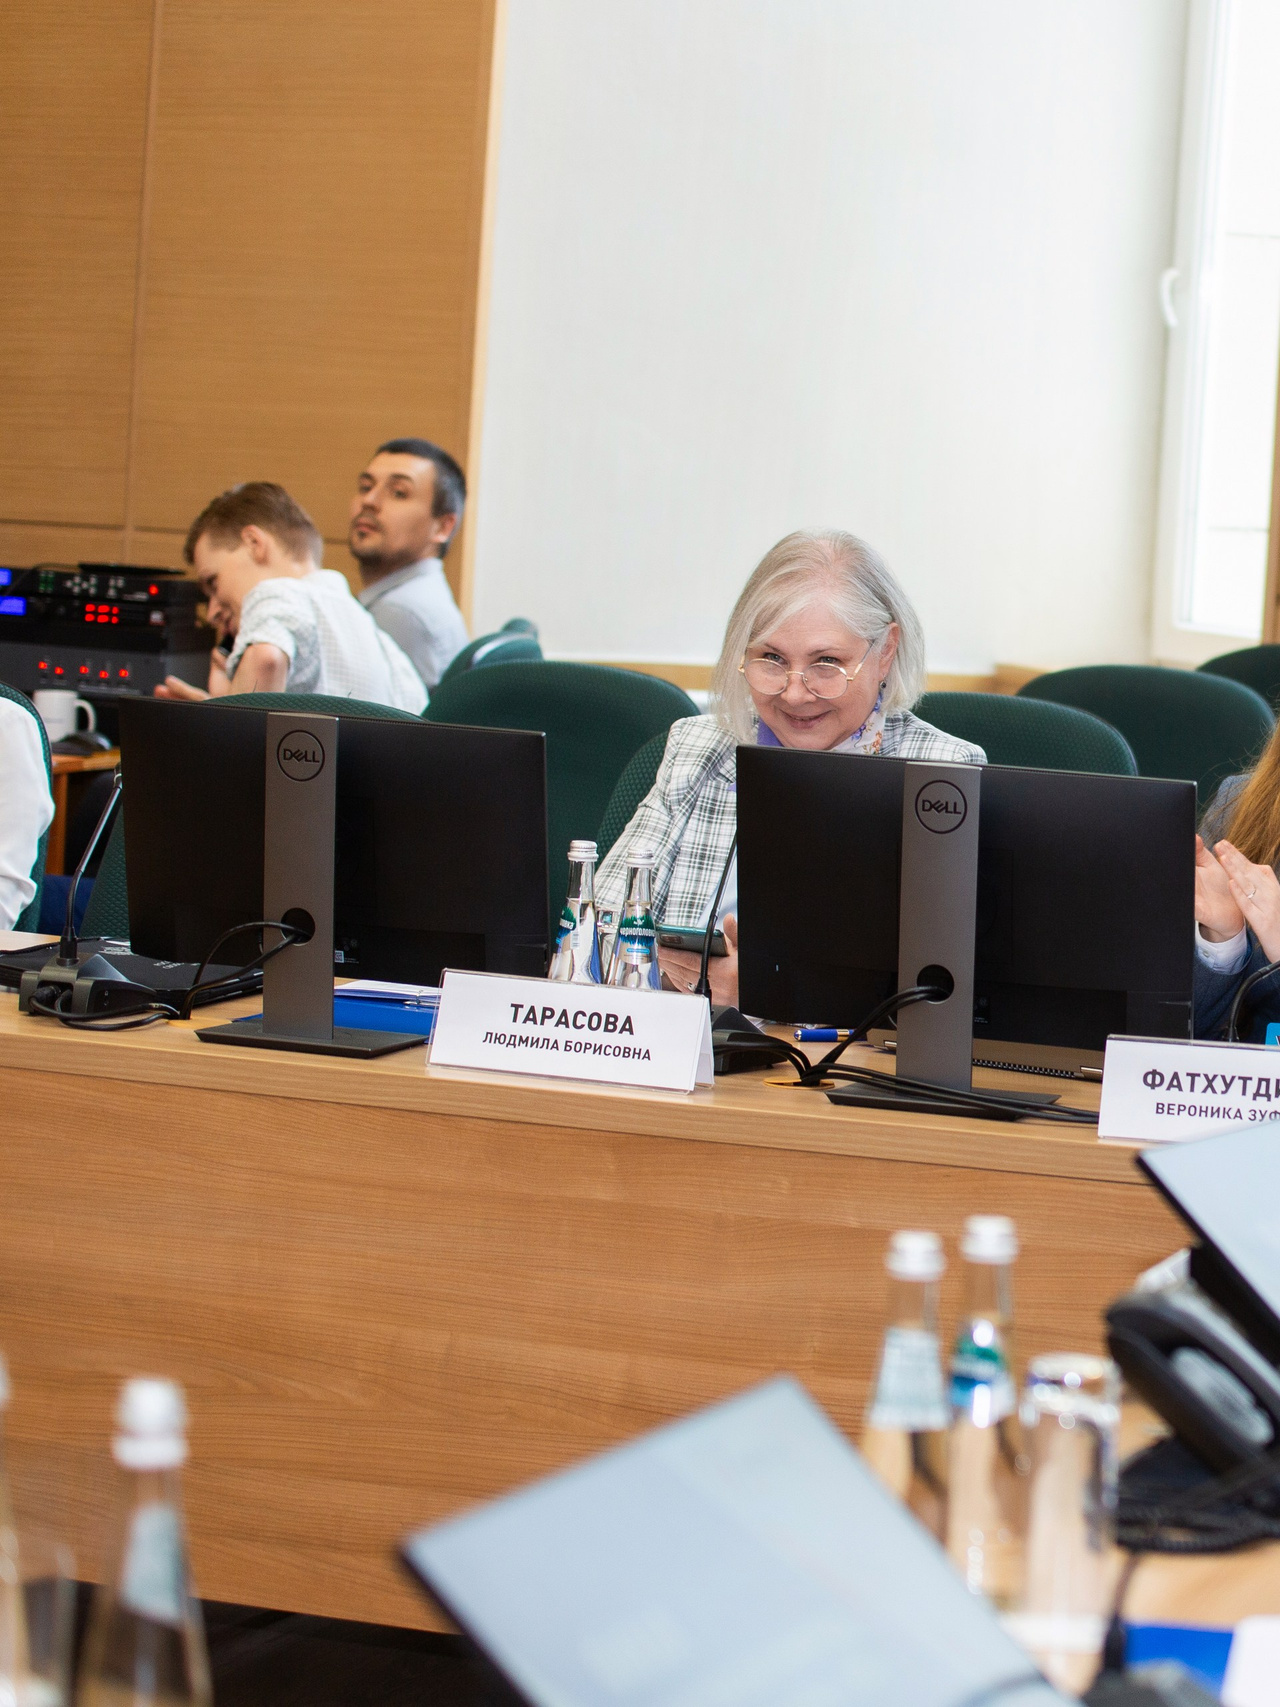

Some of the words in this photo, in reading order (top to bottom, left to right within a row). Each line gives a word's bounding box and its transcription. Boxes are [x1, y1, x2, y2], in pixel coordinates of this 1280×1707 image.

[283, 748, 320, 763] DELL
[921, 799, 962, 815] DELL
[510, 1003, 635, 1036] ТАРАСОВА
[482, 1031, 560, 1051] ЛЮДМИЛА
[563, 1040, 652, 1061] БОРИСОВНА
[1155, 1102, 1243, 1121] ВЕРОНИКА
